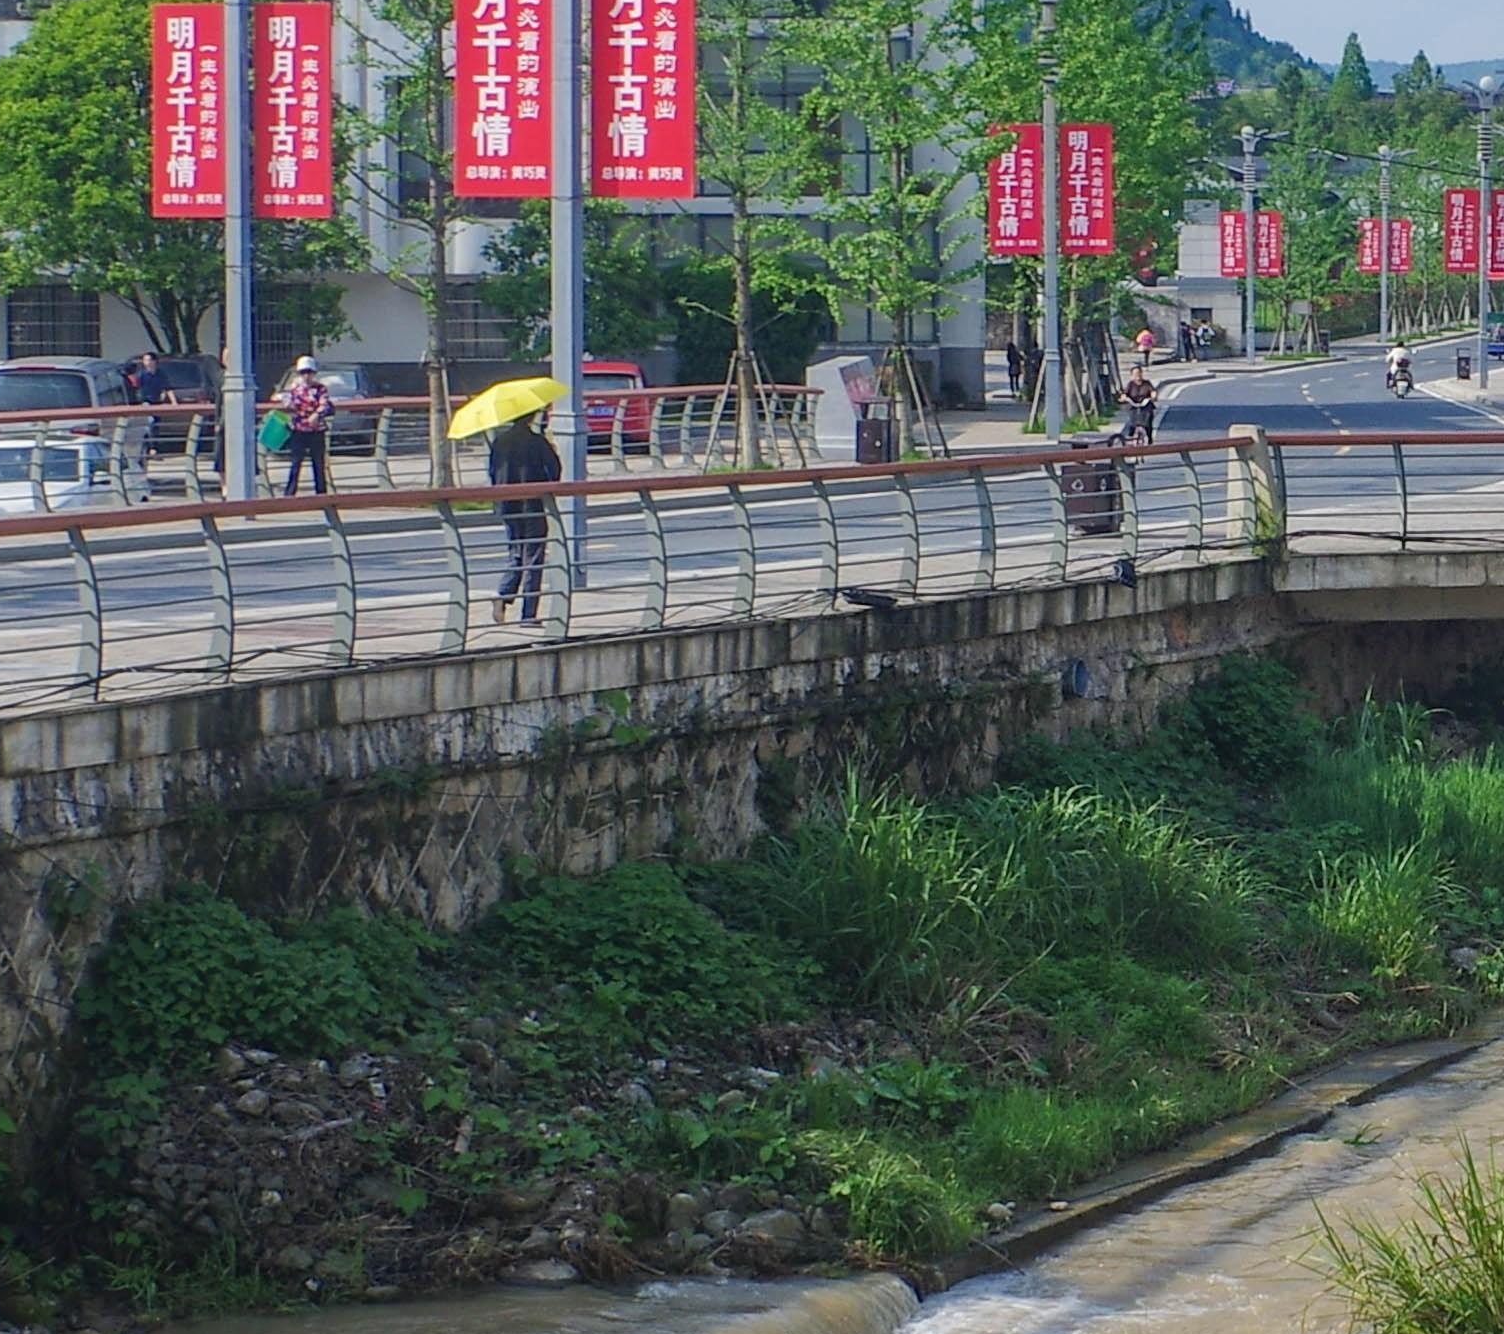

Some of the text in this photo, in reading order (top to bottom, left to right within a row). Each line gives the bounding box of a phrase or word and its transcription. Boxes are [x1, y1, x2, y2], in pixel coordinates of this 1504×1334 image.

[166, 16, 197, 188] 明月千古情
[267, 16, 298, 188] 明月千古情
[998, 144, 1019, 237] 月千古情
[1068, 131, 1089, 236] 明月千古情
[1450, 193, 1464, 261] 明月千古情
